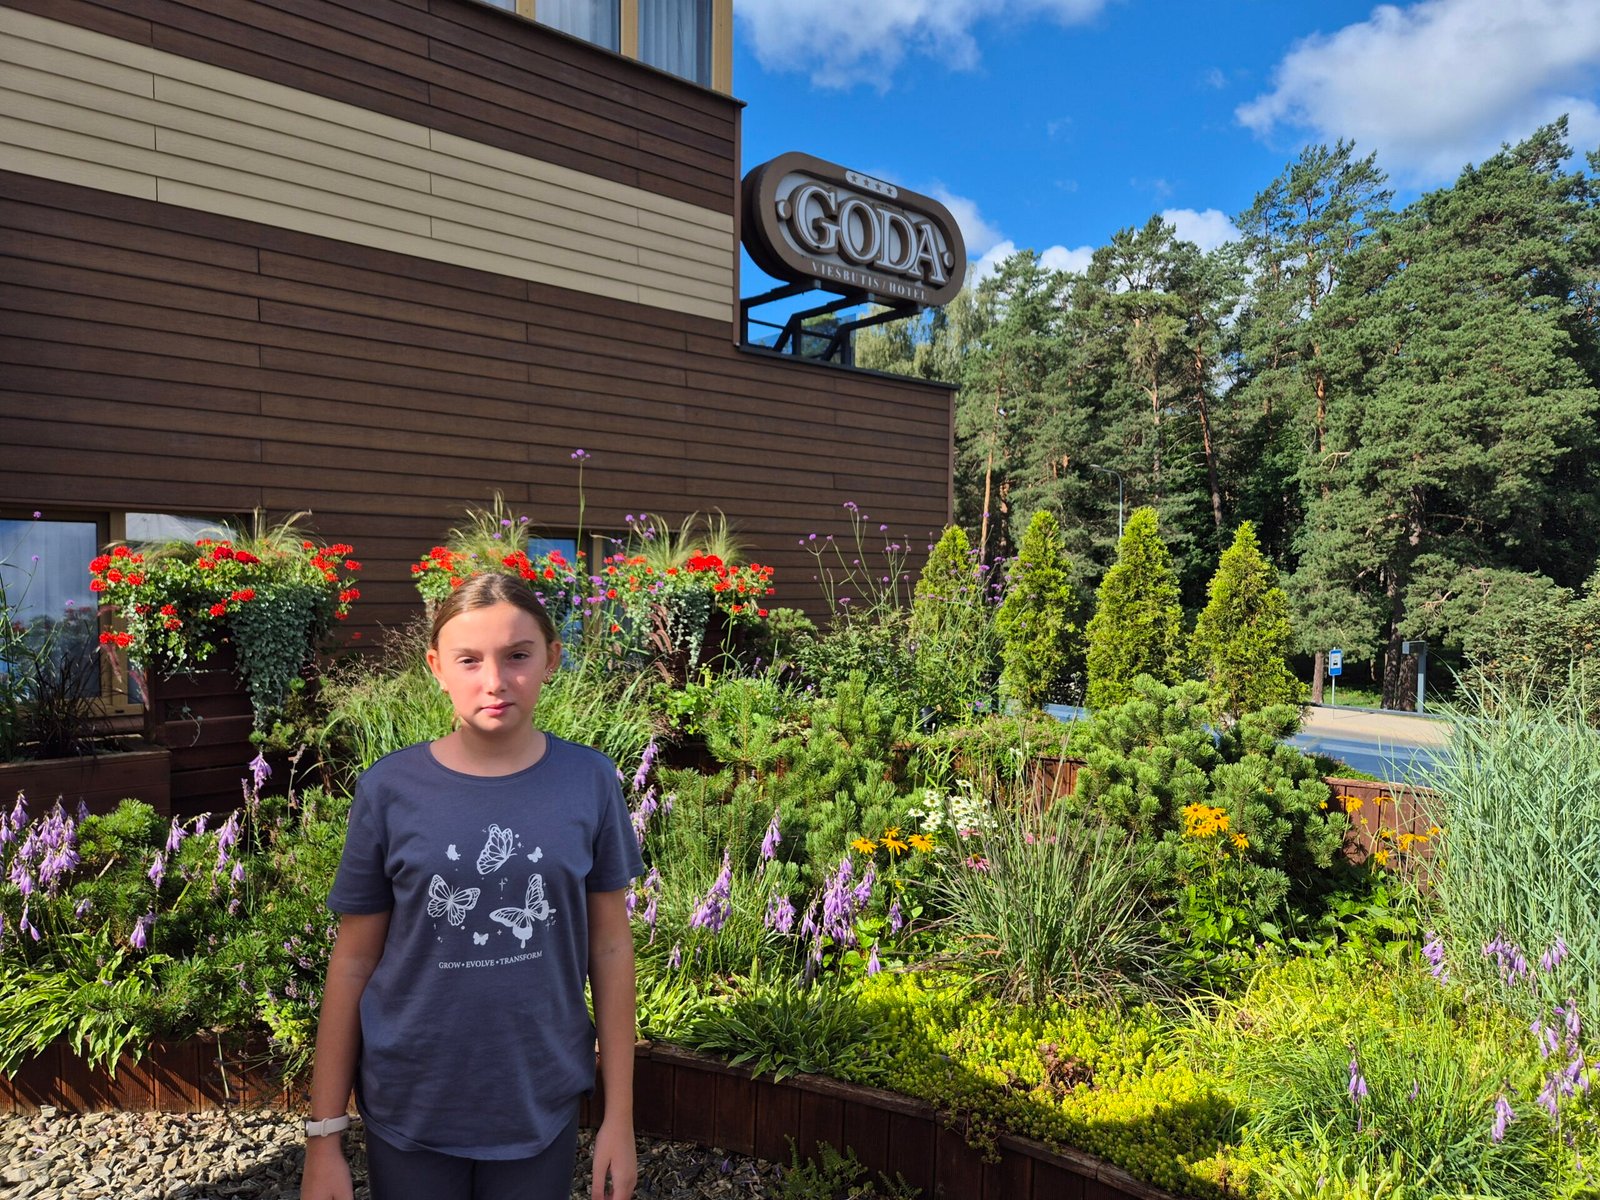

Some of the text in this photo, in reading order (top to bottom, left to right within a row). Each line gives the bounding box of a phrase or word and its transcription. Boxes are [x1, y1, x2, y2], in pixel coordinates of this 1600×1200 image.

[793, 184, 947, 284] GODA
[889, 282, 927, 302] HOTEL
[438, 950, 543, 969] GROW EVOLVE TRANSFORM
